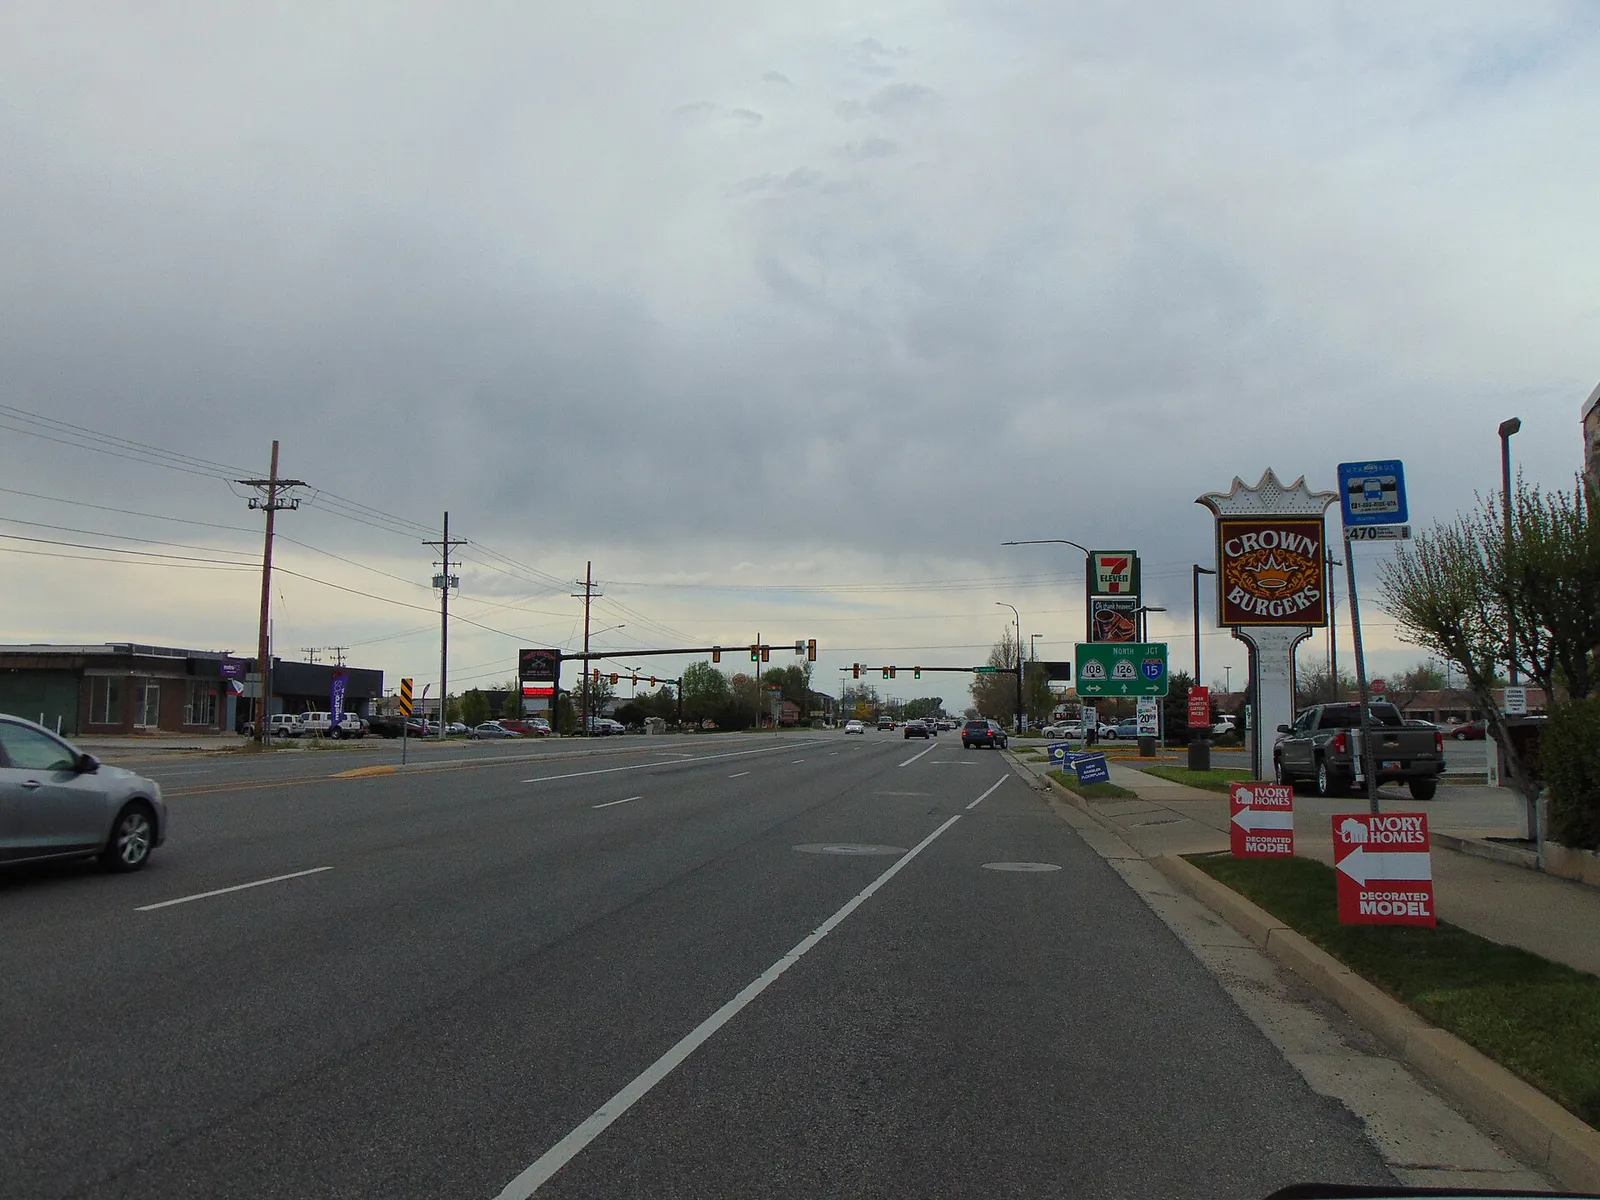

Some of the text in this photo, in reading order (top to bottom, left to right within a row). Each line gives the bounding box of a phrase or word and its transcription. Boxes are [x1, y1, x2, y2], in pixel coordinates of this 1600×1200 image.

[1350, 527, 1377, 540] 470
[1224, 530, 1319, 558] CROWN
[1101, 557, 1128, 593] 7
[1103, 601, 1115, 610] thank
[1227, 585, 1320, 617] BURGERS
[1113, 647, 1134, 655] NORTH
[1146, 647, 1158, 655] JCT
[1086, 665, 1101, 674] 108
[1116, 665, 1132, 674] 126
[1146, 665, 1158, 676] 15
[1255, 788, 1290, 798] IVORY
[1255, 797, 1290, 806] HOMES
[1369, 817, 1423, 831] IVORY
[1370, 831, 1425, 843] HOMES
[1246, 843, 1292, 853] MODEL
[1359, 892, 1429, 901] DECORATED
[1360, 901, 1431, 916] MODEL
